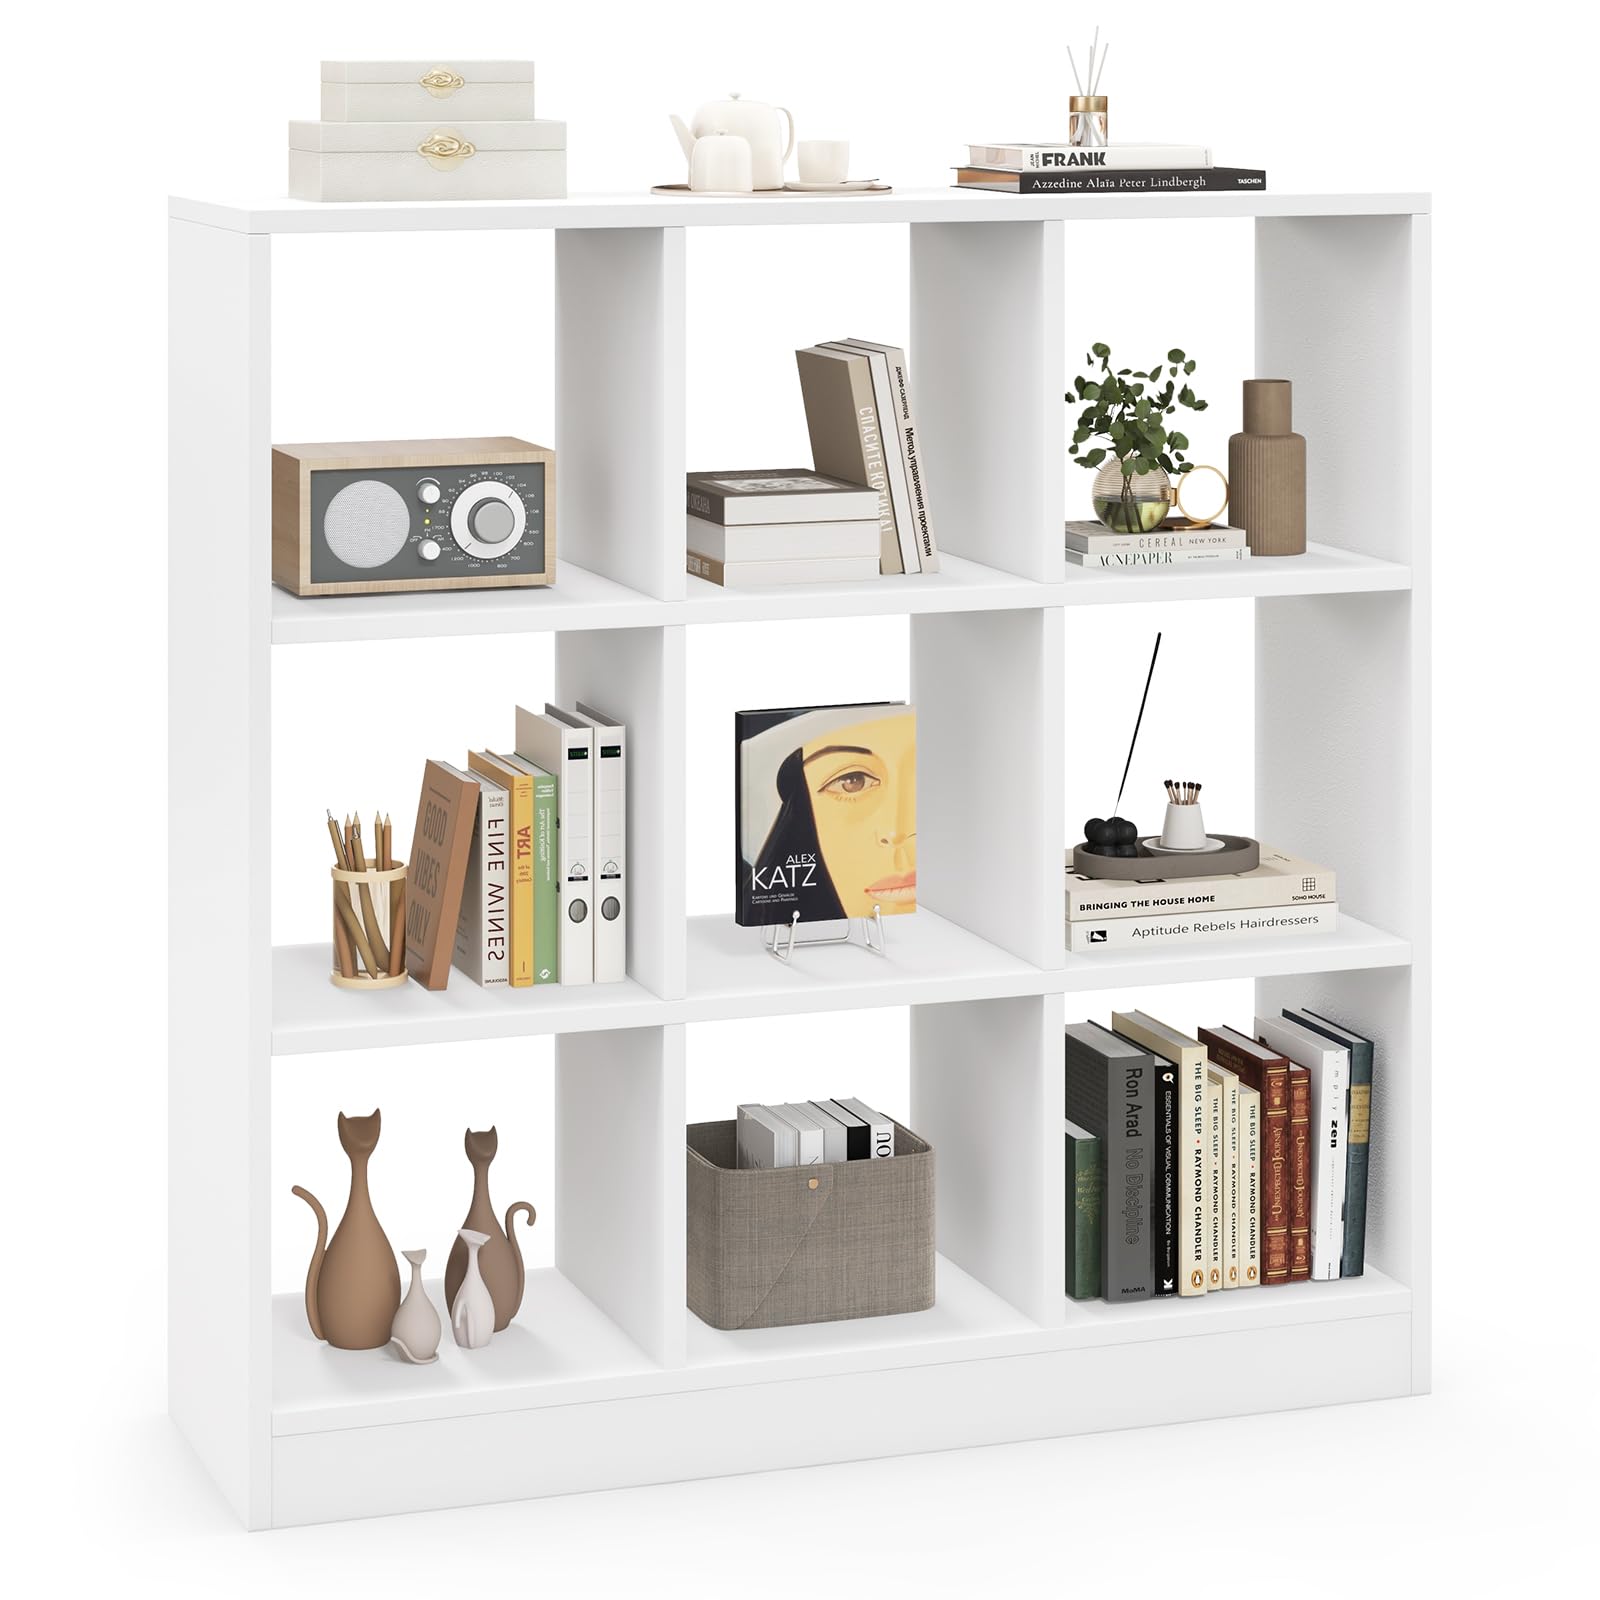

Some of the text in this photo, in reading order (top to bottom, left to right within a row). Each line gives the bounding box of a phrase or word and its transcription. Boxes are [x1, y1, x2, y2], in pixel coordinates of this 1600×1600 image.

[1042, 152, 1106, 167] FRANK
[1032, 176, 1206, 189] Azzedine Alaïa Peter Lindbergh
[860, 406, 882, 470] СПАСИТЕ
[904, 427, 932, 557] Метод управления проектами
[1139, 536, 1183, 548] CEREAL
[1099, 551, 1173, 567] ACNEPAPER
[422, 800, 448, 846] GOOD
[786, 853, 816, 864] ALEX
[414, 848, 441, 898] VIBES
[752, 863, 816, 891] KATZ
[1079, 895, 1216, 912] BRINGING THE HOUSE HOME
[406, 899, 430, 945] ONLY
[1131, 914, 1319, 939] Aptitude Rebels Hairdressers
[1165, 1136, 1172, 1146] OF
[1122, 1068, 1144, 1244] Ron Arad No Discipline
